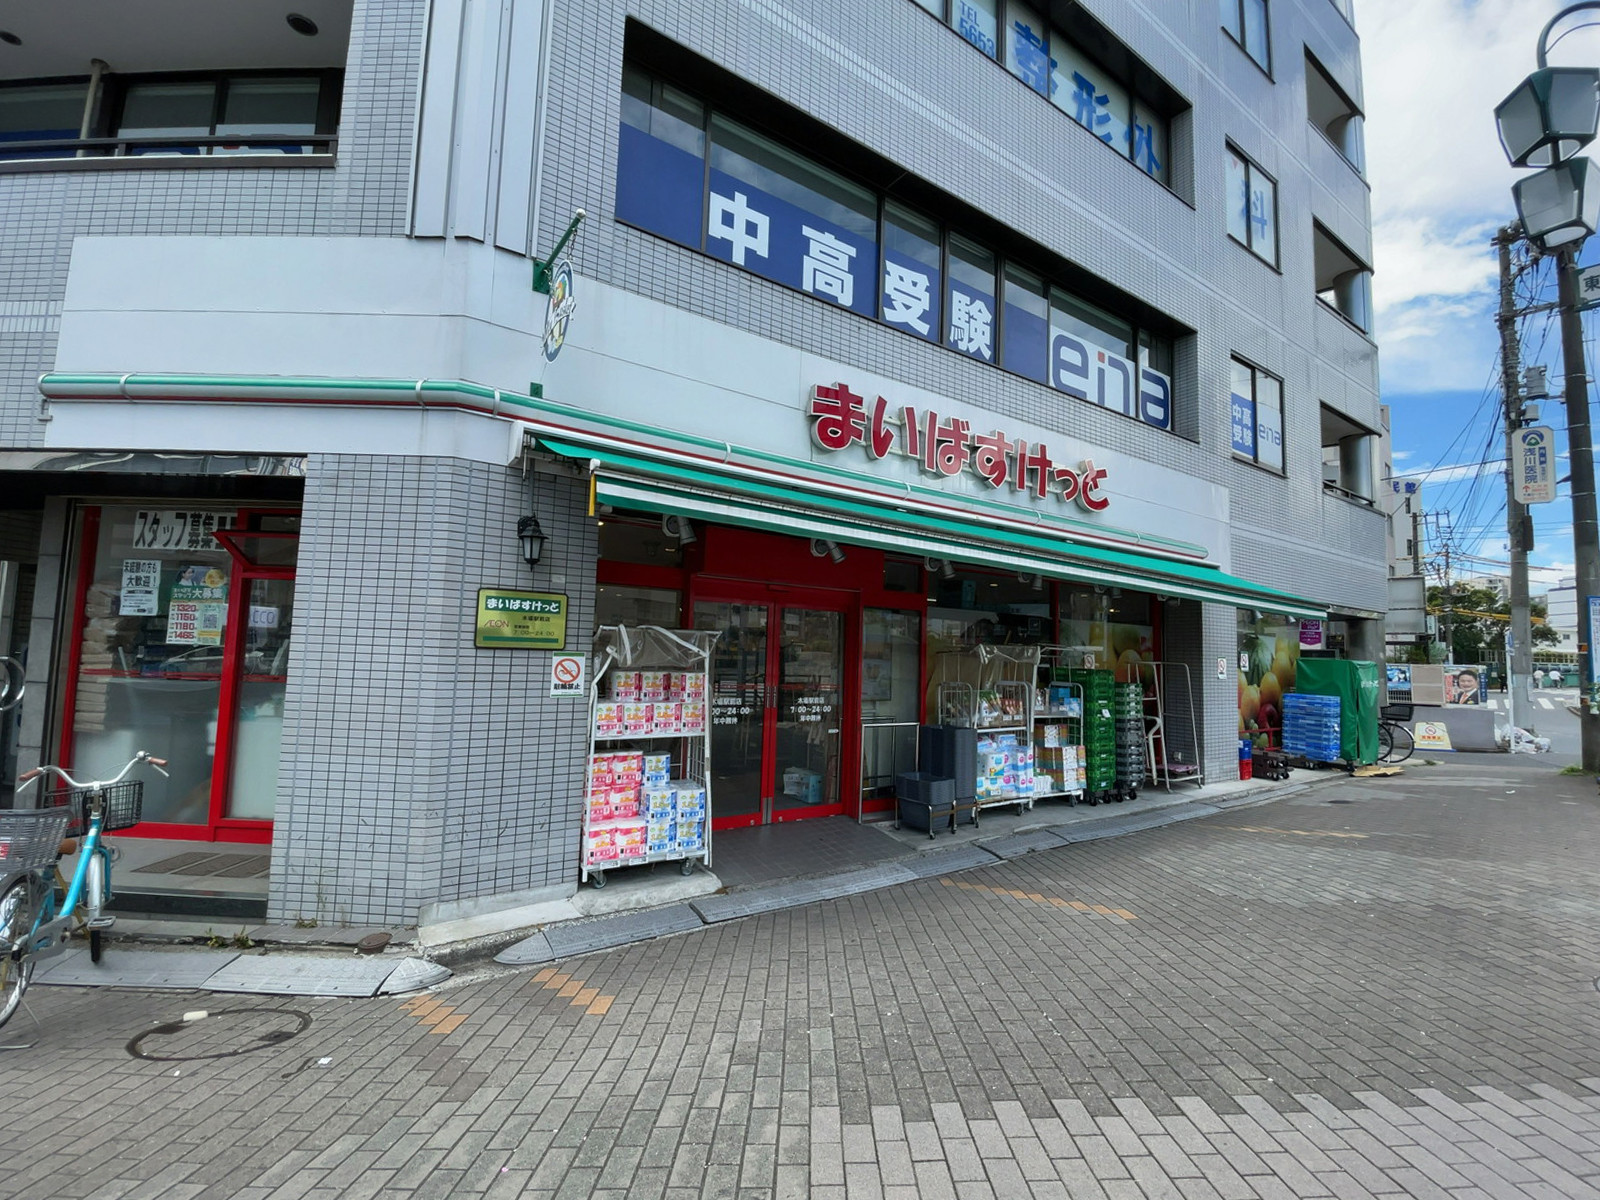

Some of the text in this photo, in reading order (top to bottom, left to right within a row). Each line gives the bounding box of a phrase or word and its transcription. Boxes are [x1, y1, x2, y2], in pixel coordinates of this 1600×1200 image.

[960, 1, 980, 27] TEL
[960, 17, 995, 58] 5653
[708, 190, 992, 360] 中高受験
[811, 382, 1110, 512] まいばすけっと
[486, 598, 559, 612] まいばすけっと
